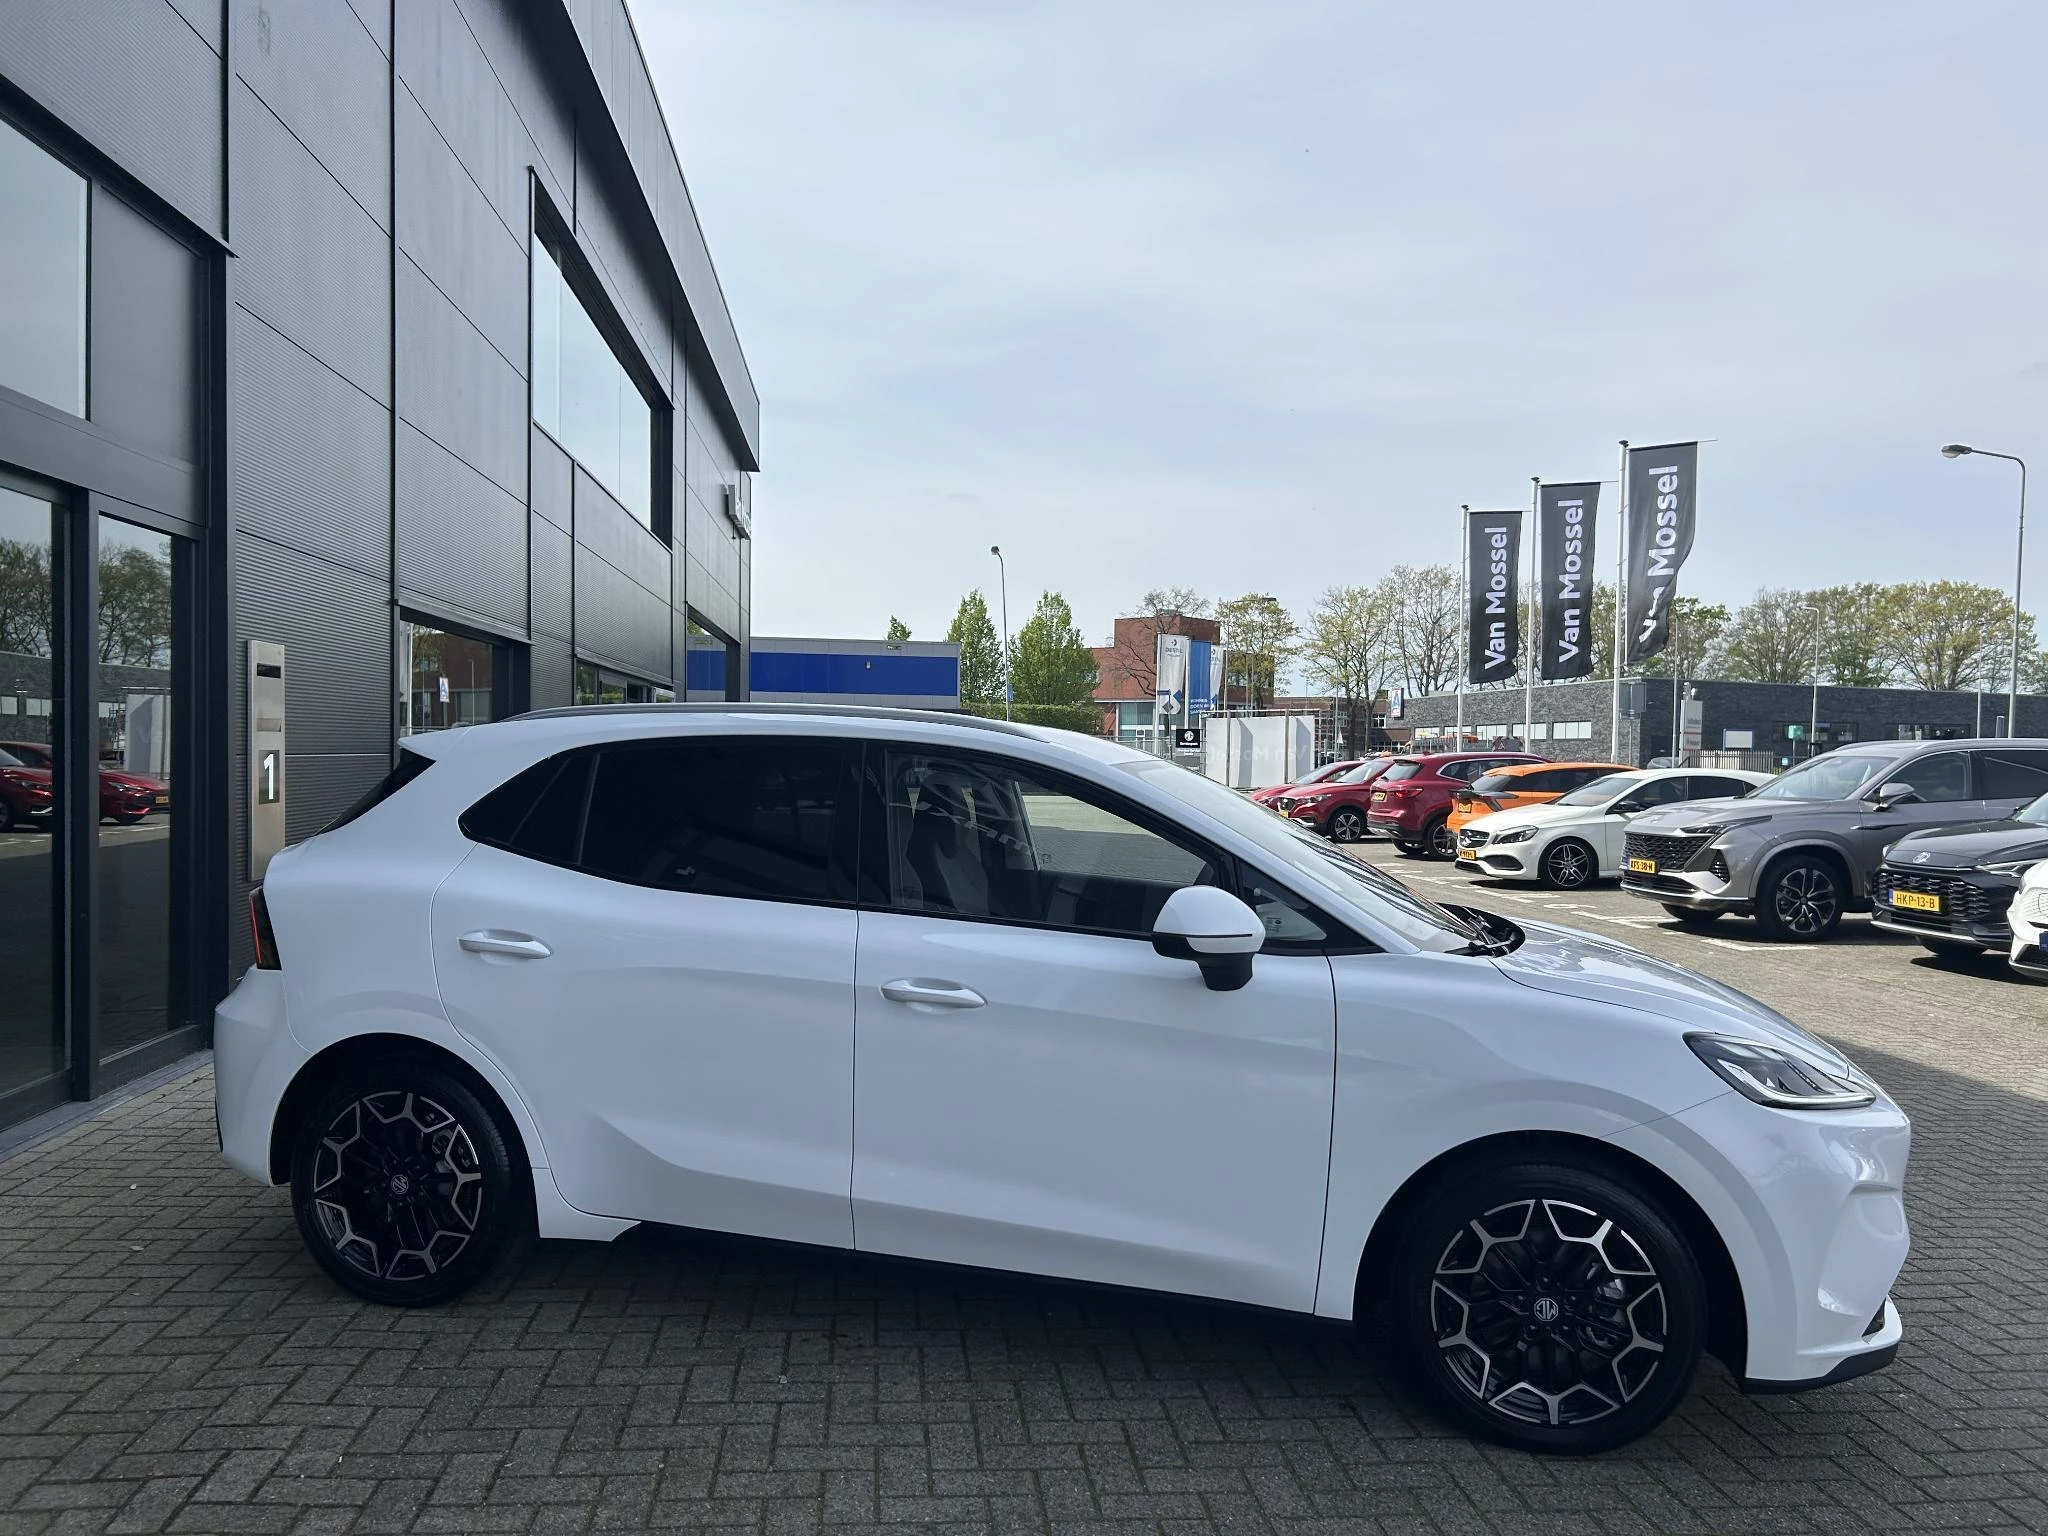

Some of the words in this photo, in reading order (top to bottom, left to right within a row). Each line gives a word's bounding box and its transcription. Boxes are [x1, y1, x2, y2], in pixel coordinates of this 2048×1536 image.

[1647, 465, 1678, 577] Mossel
[1484, 526, 1507, 614] Mossel
[1557, 499, 1583, 600] Mossel
[1484, 622, 1506, 670] Van
[1558, 608, 1581, 663] Van
[263, 753, 274, 800] 1
[1896, 893, 1935, 909] HKP-13-B
[1534, 1298, 1558, 1321] MG
